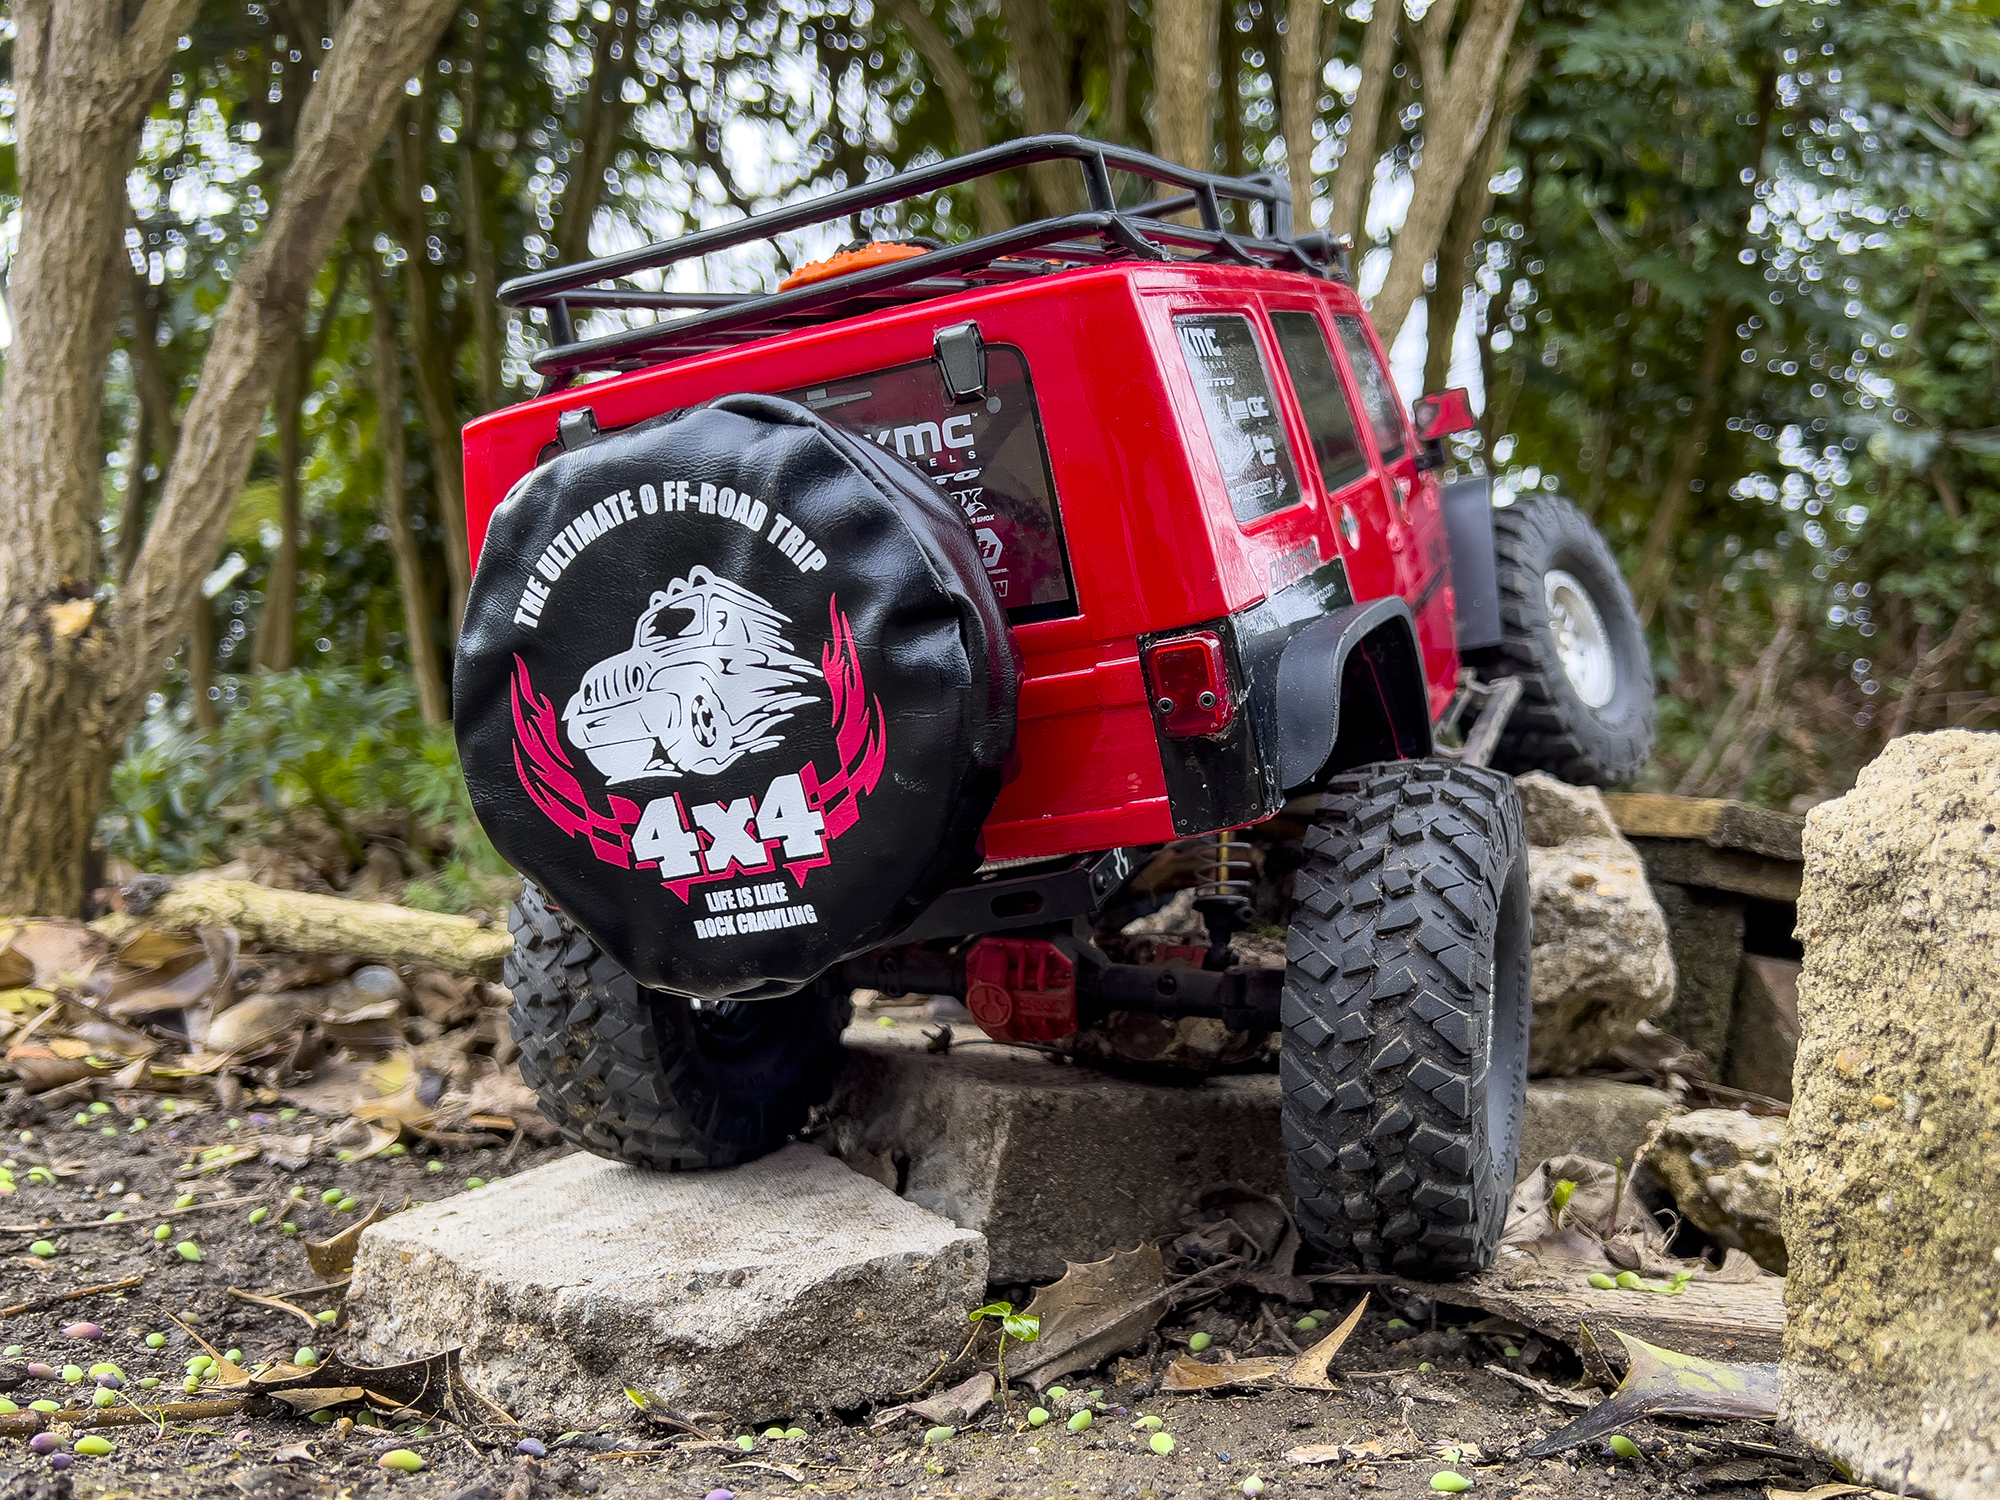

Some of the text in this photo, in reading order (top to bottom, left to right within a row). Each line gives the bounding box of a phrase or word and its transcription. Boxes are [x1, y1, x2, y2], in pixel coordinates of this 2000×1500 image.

[513, 574, 551, 629] THE
[535, 489, 639, 582] ULTIMATE
[766, 512, 828, 574] TRIP
[630, 772, 826, 880] 4x4
[693, 903, 819, 940] ROCK CRAWLING
[704, 881, 790, 913] LIFE IS LIKE
